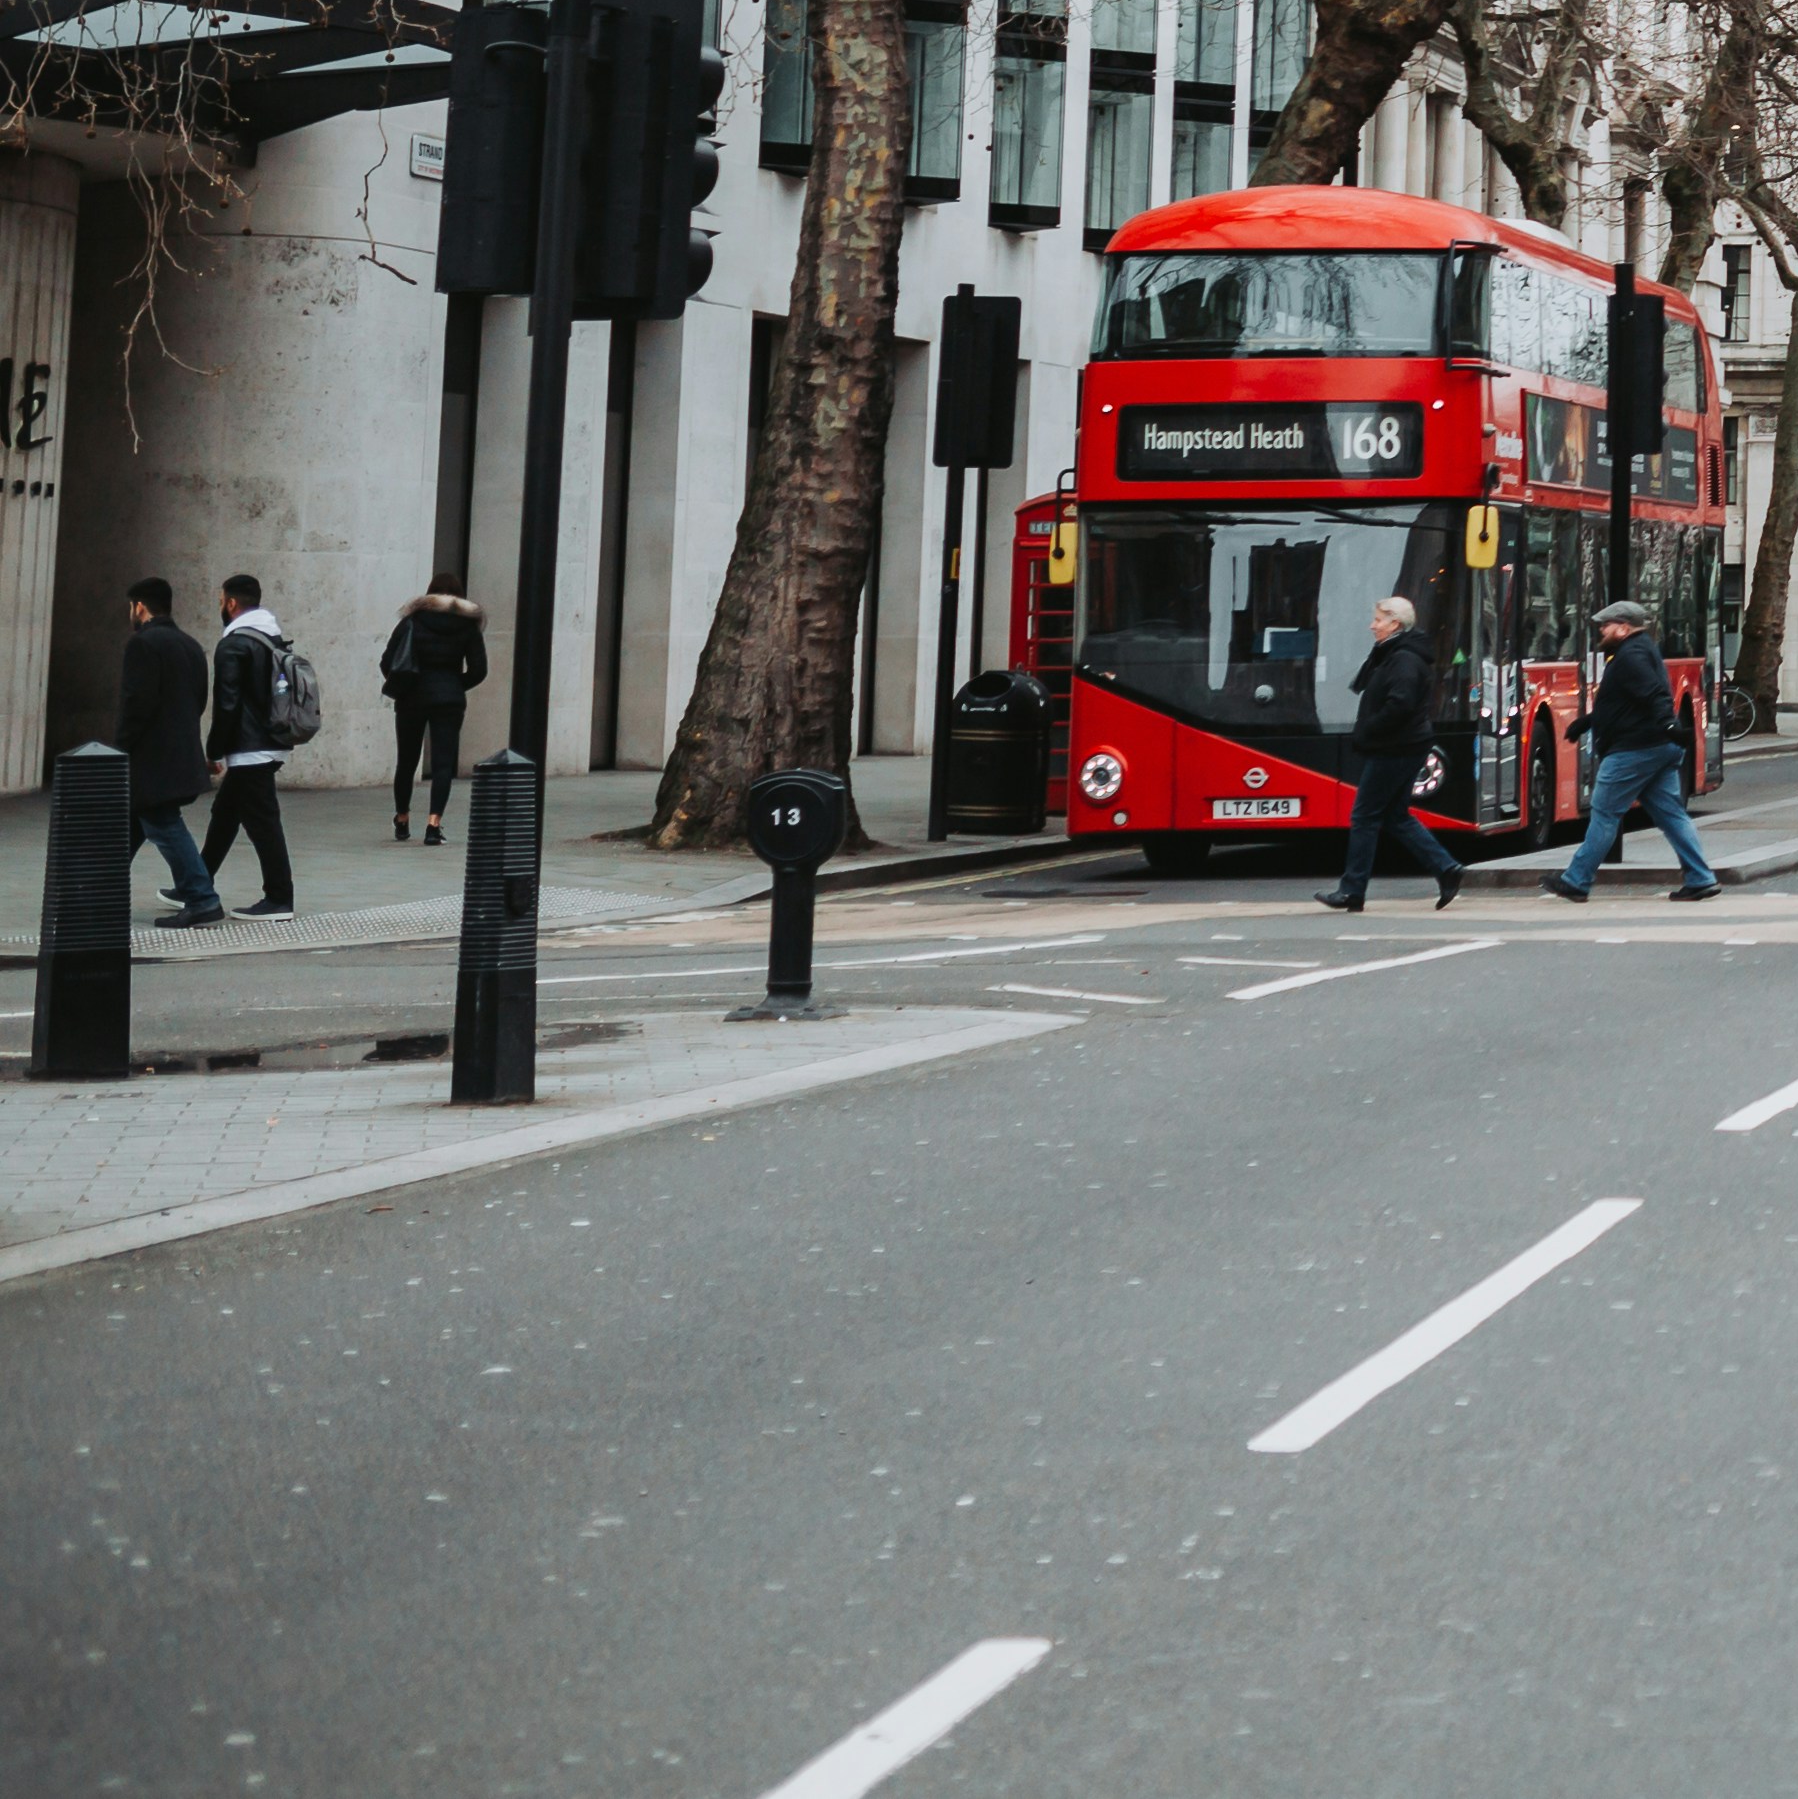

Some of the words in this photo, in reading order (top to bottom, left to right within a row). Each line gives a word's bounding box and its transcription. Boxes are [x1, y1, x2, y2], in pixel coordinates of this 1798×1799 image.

[418, 142, 443, 160] STRAND
[1143, 422, 1246, 458] Hampstead
[1250, 422, 1305, 450] Heath
[1342, 416, 1402, 460] 168
[771, 807, 801, 826] 13
[1222, 802, 1253, 816] LTZ
[1256, 800, 1291, 815] 1649
